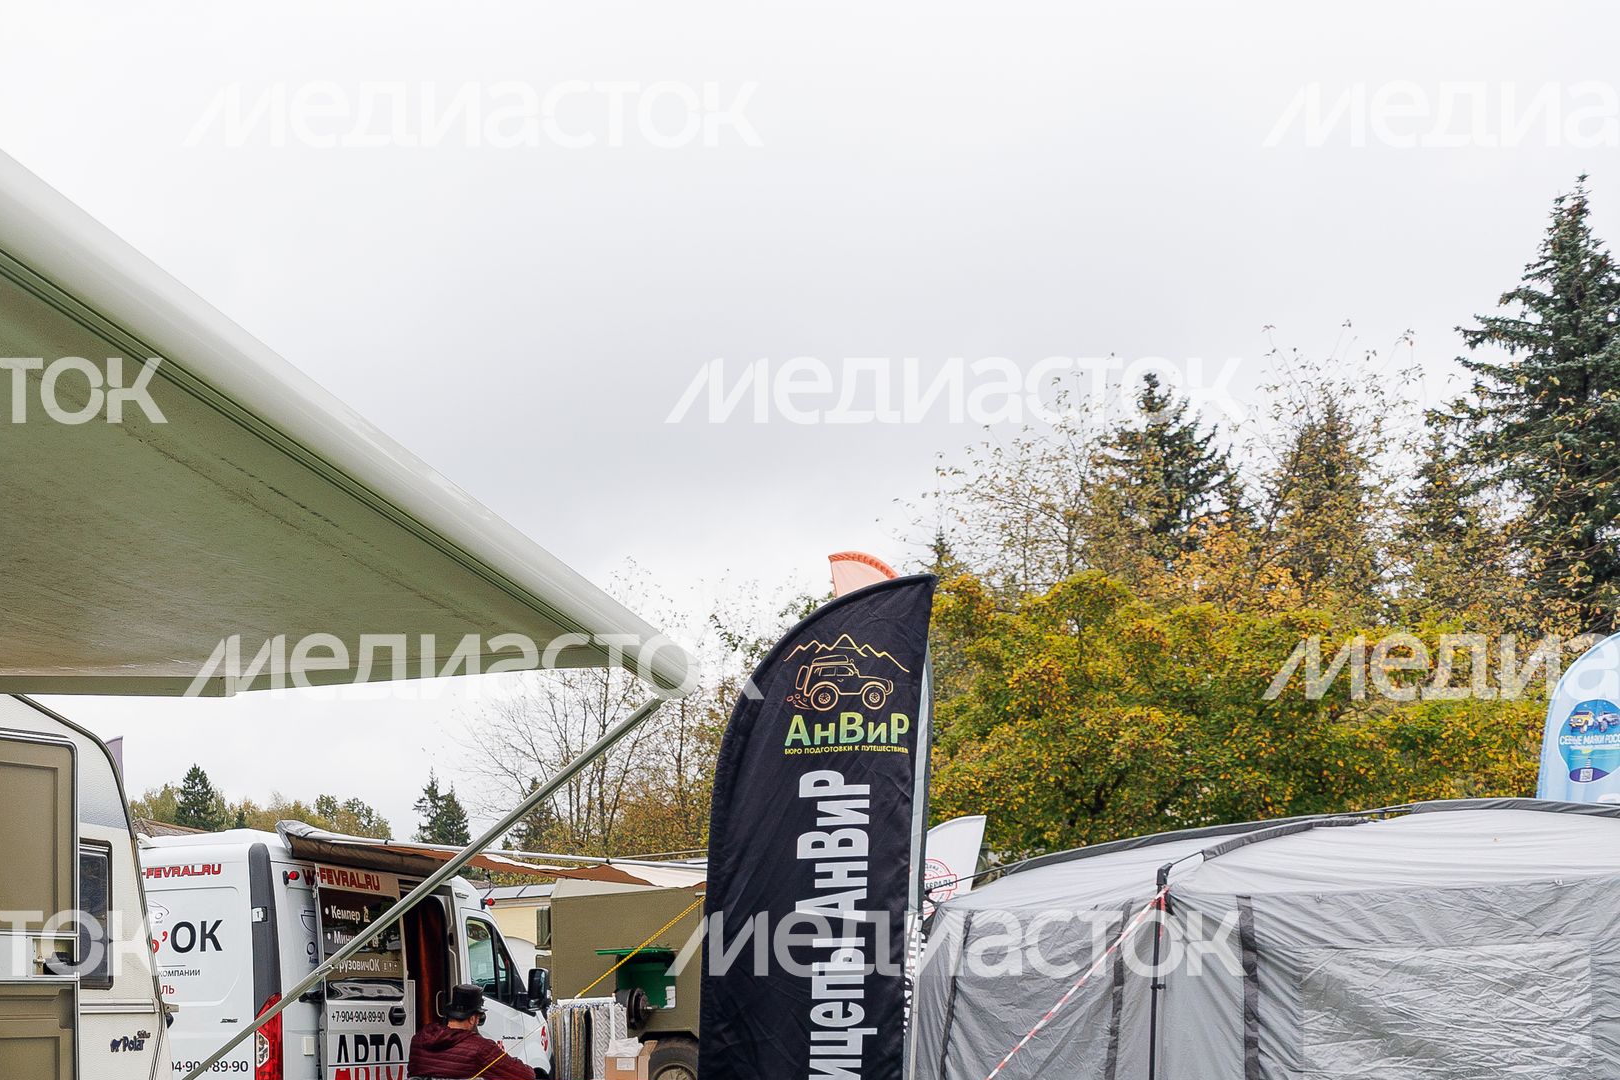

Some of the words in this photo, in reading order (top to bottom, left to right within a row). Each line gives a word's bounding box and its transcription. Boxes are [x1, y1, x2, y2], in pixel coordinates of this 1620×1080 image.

[804, 745, 853, 754] ПОДГОТОВКИ
[331, 905, 360, 924] Кемпер
[337, 958, 381, 973] рузовичОК
